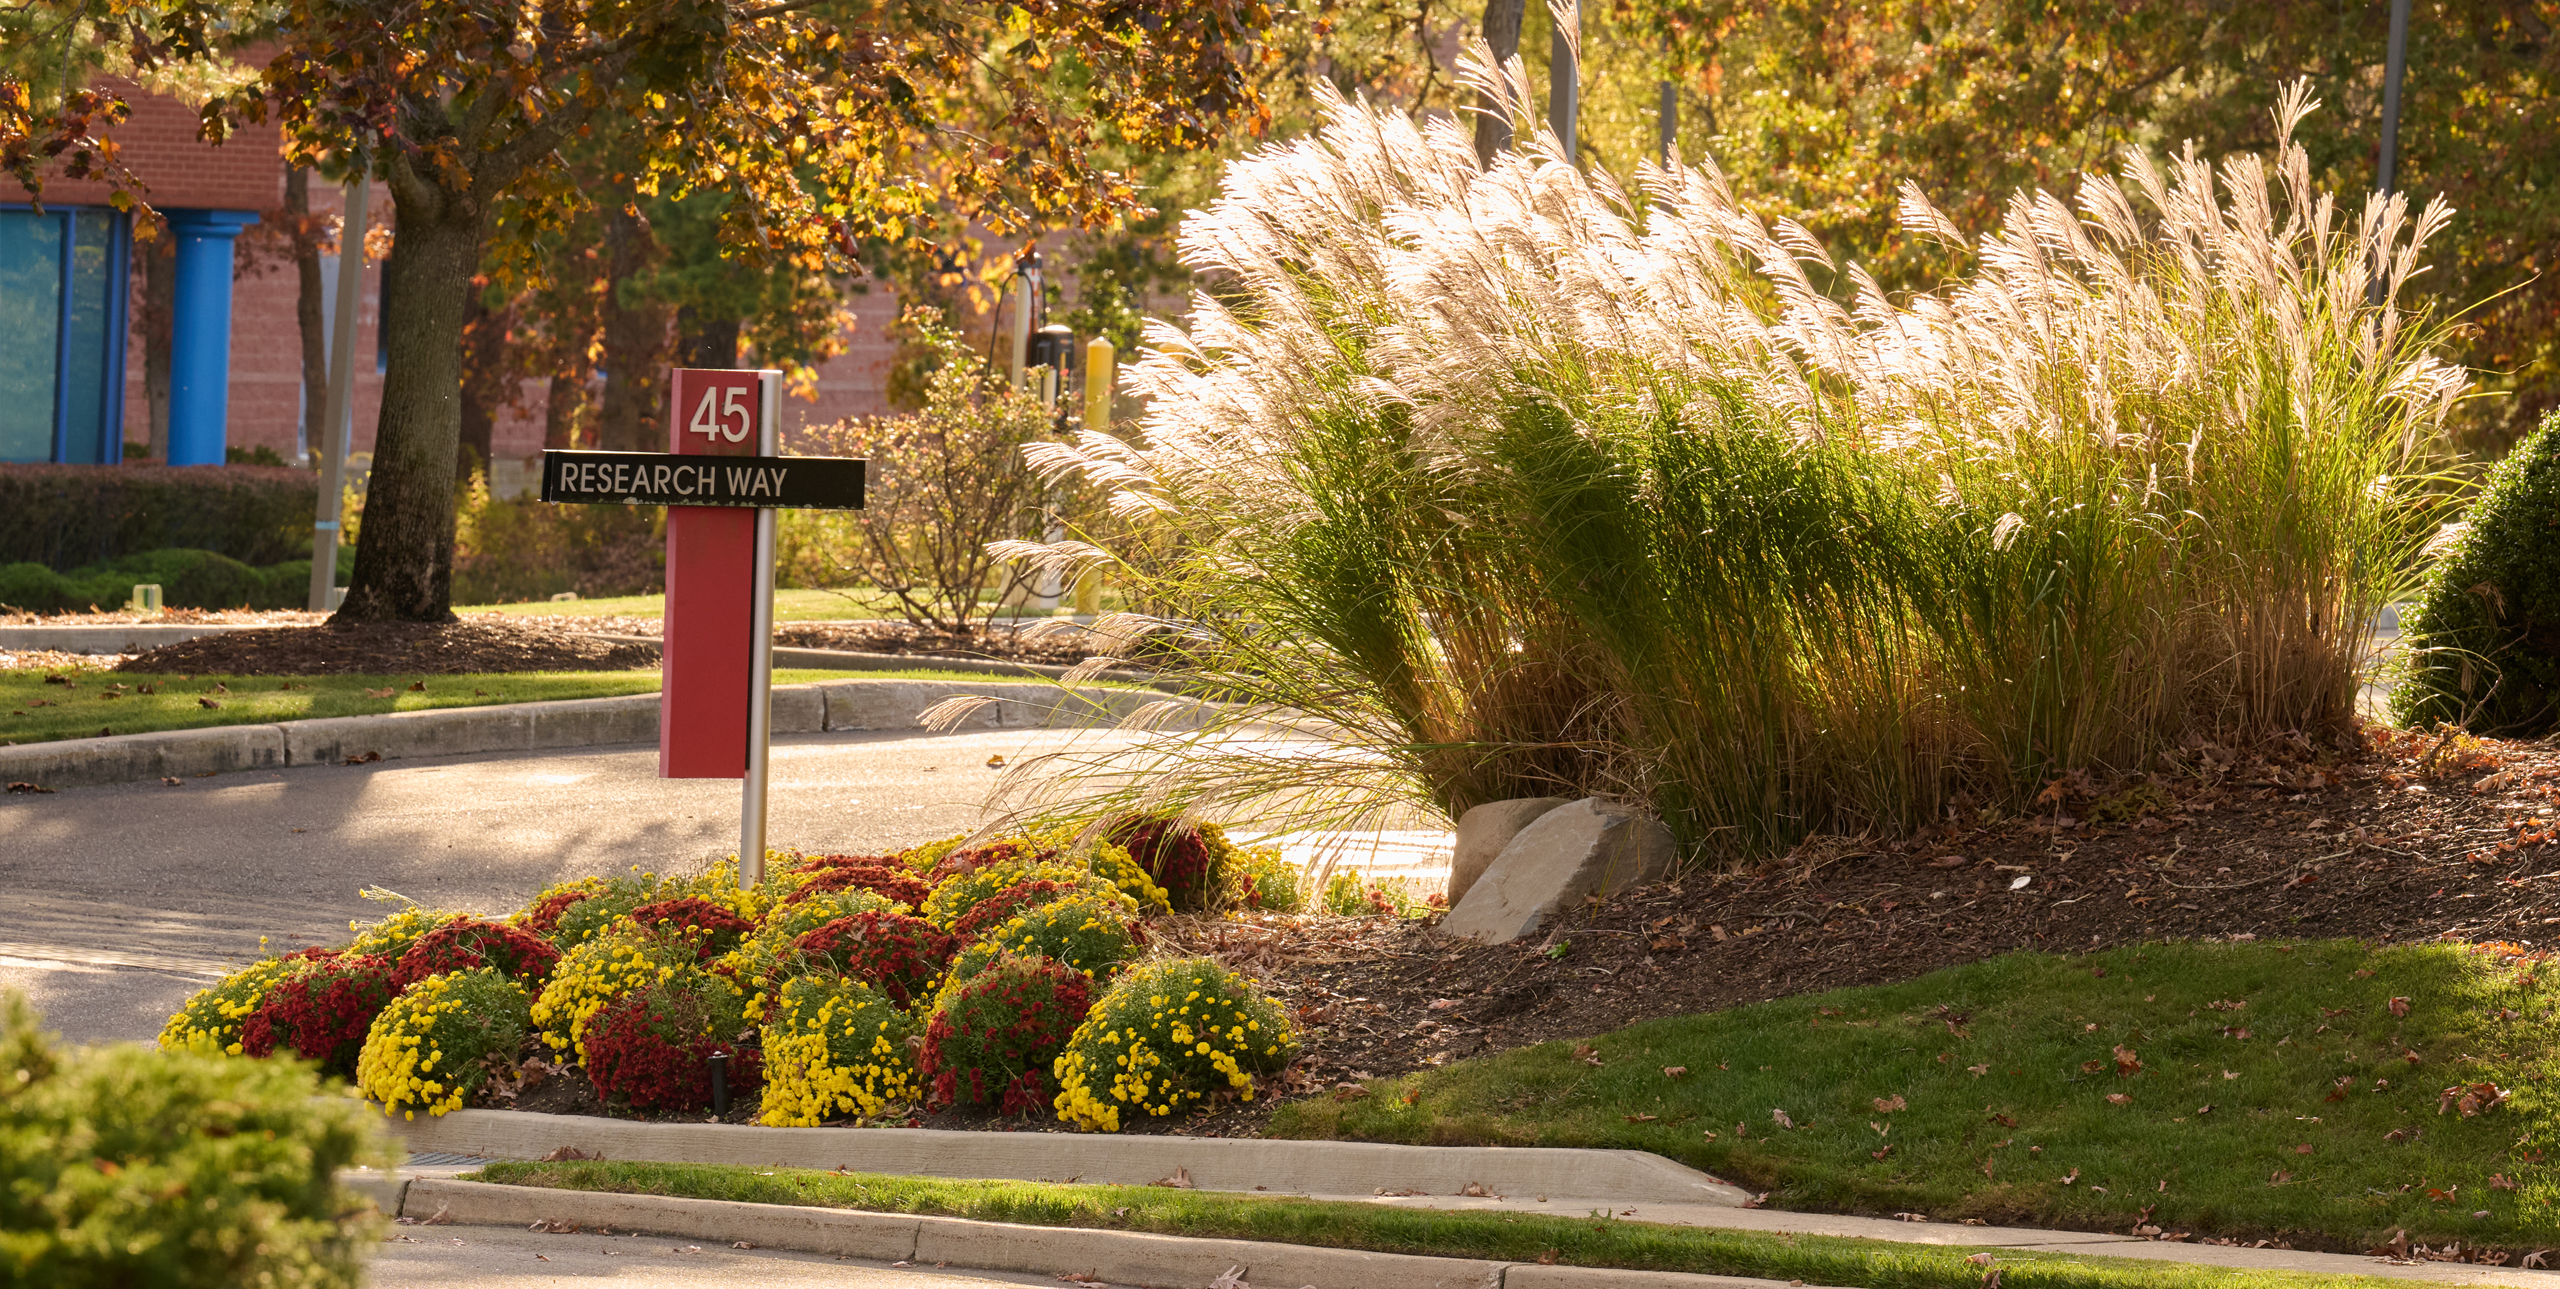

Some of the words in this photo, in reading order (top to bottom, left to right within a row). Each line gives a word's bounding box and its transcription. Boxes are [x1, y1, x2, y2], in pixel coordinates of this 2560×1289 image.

[689, 386, 750, 443] 45
[560, 462, 716, 495] RESEARCH
[726, 466, 788, 497] WAY
